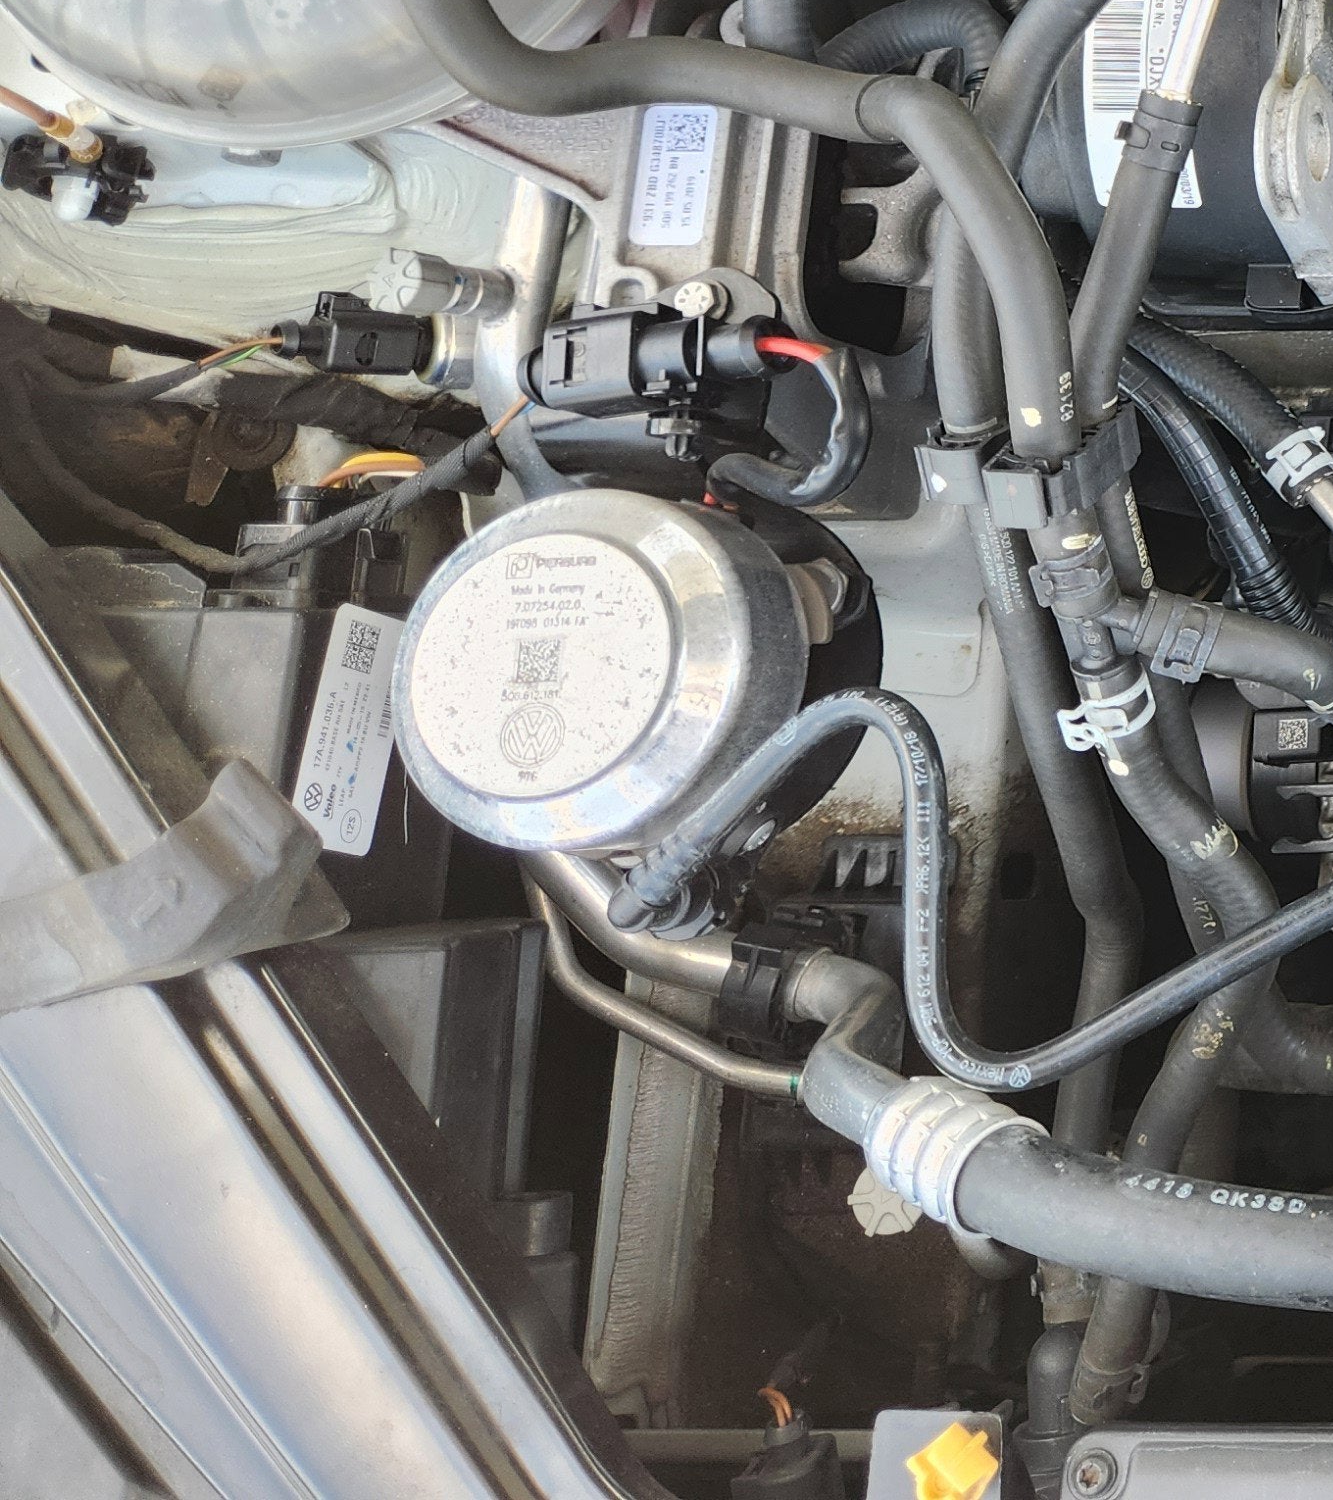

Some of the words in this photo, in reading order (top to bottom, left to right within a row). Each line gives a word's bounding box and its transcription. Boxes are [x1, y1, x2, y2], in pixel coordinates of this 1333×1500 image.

[904, 729, 929, 787] 17/10/18
[322, 784, 338, 818] Valeo
[346, 815, 356, 836] 12S
[916, 908, 930, 932] F-2
[916, 946, 930, 967] 041
[918, 974, 930, 998] 612
[958, 1060, 1005, 1082] Mexico
